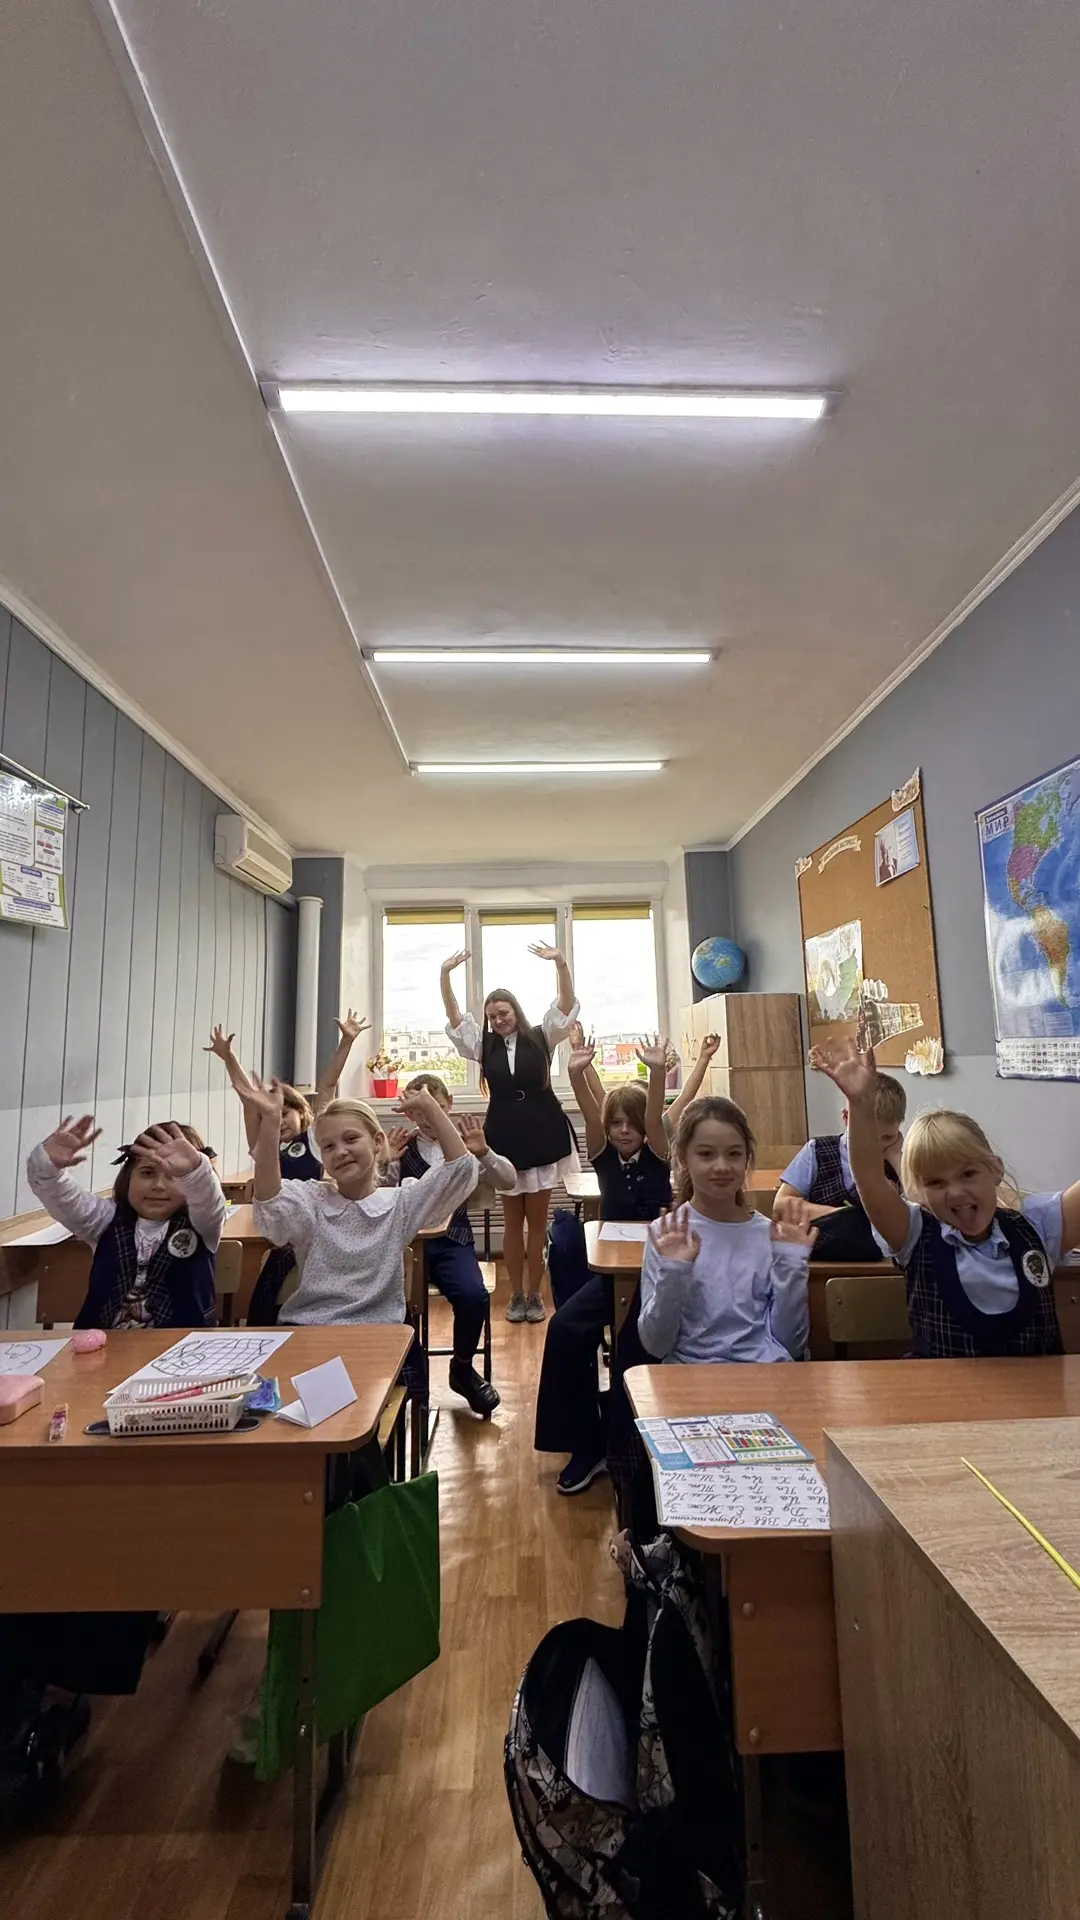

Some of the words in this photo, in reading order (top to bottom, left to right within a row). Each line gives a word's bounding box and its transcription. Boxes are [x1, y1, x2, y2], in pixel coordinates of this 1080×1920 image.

[985, 815, 1009, 836] МИР
[806, 1486, 823, 1495] Оо
[710, 1515, 746, 1526] Учусь
